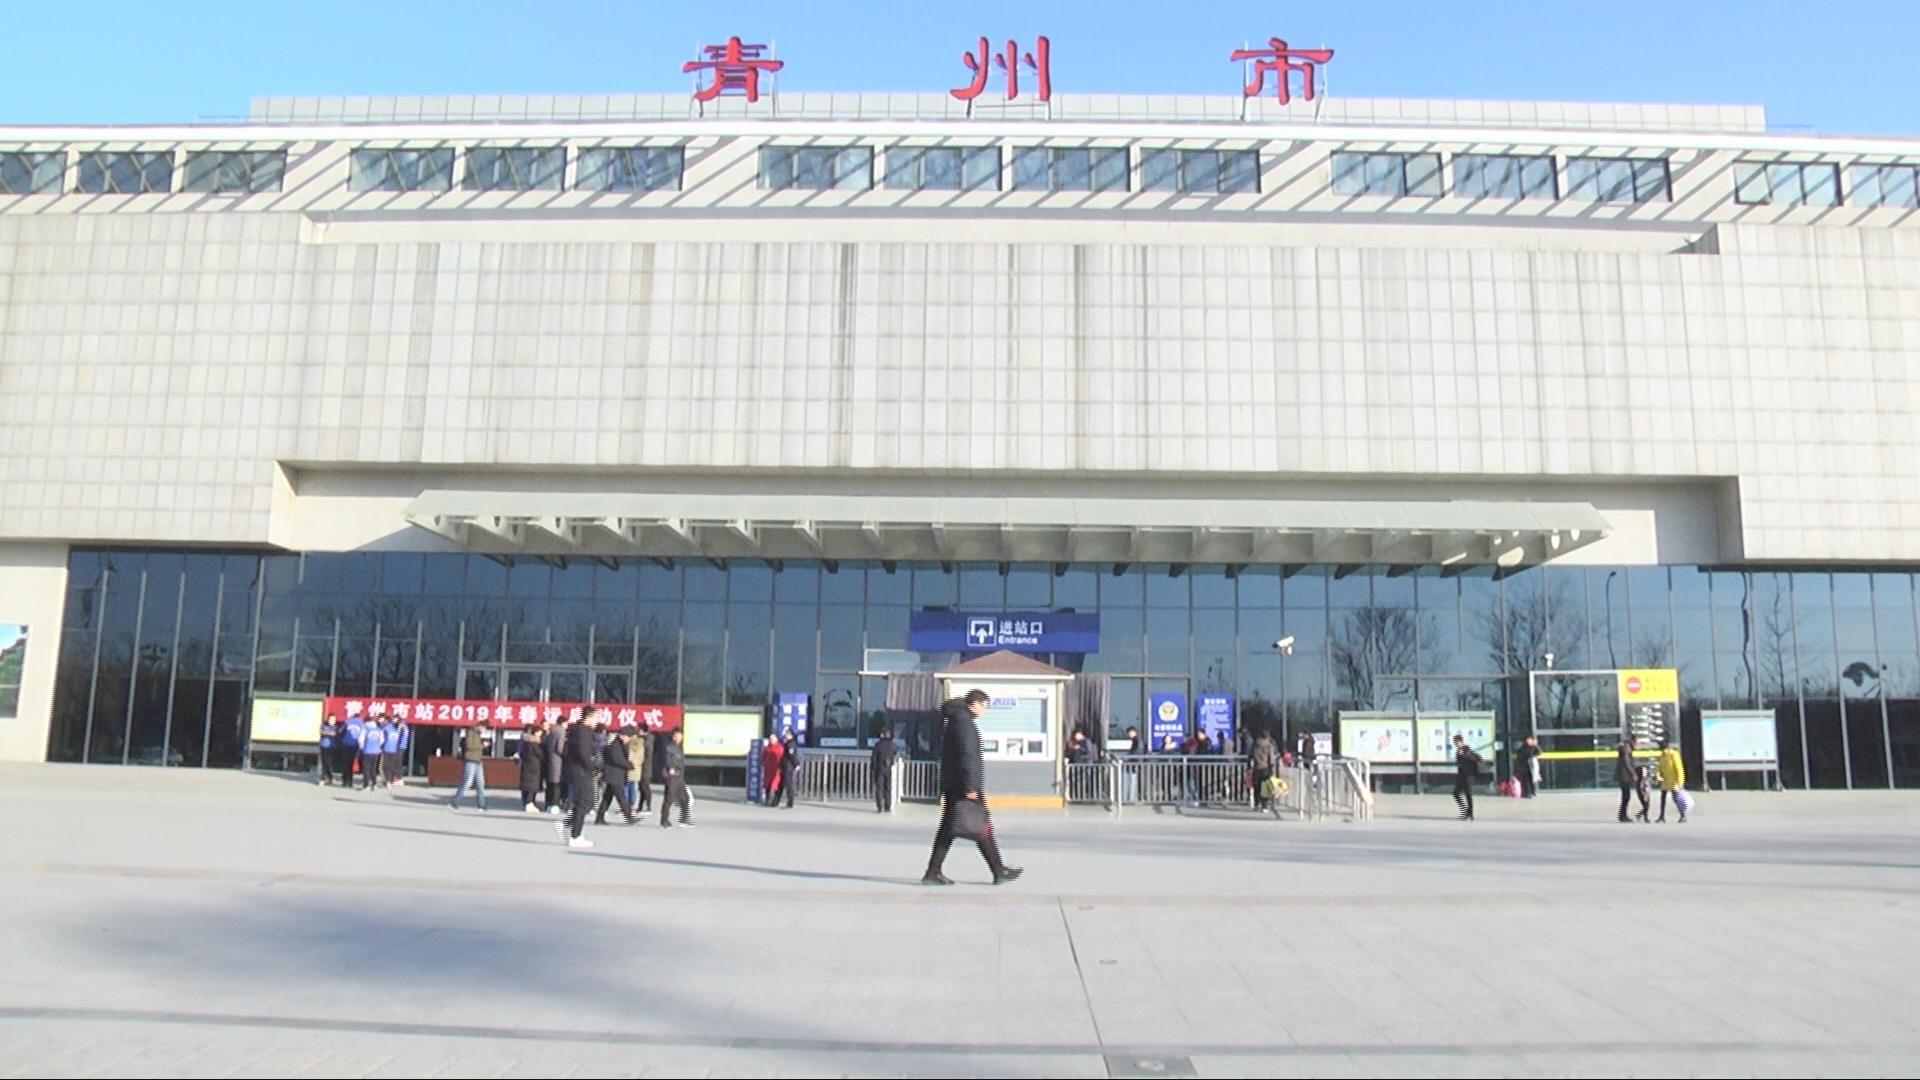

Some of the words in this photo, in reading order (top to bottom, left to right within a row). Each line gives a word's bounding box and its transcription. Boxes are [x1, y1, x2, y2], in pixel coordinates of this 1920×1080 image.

[682, 36, 1334, 105] 青州市
[999, 620, 1043, 635] 进站口
[998, 636, 1038, 645] Entrance
